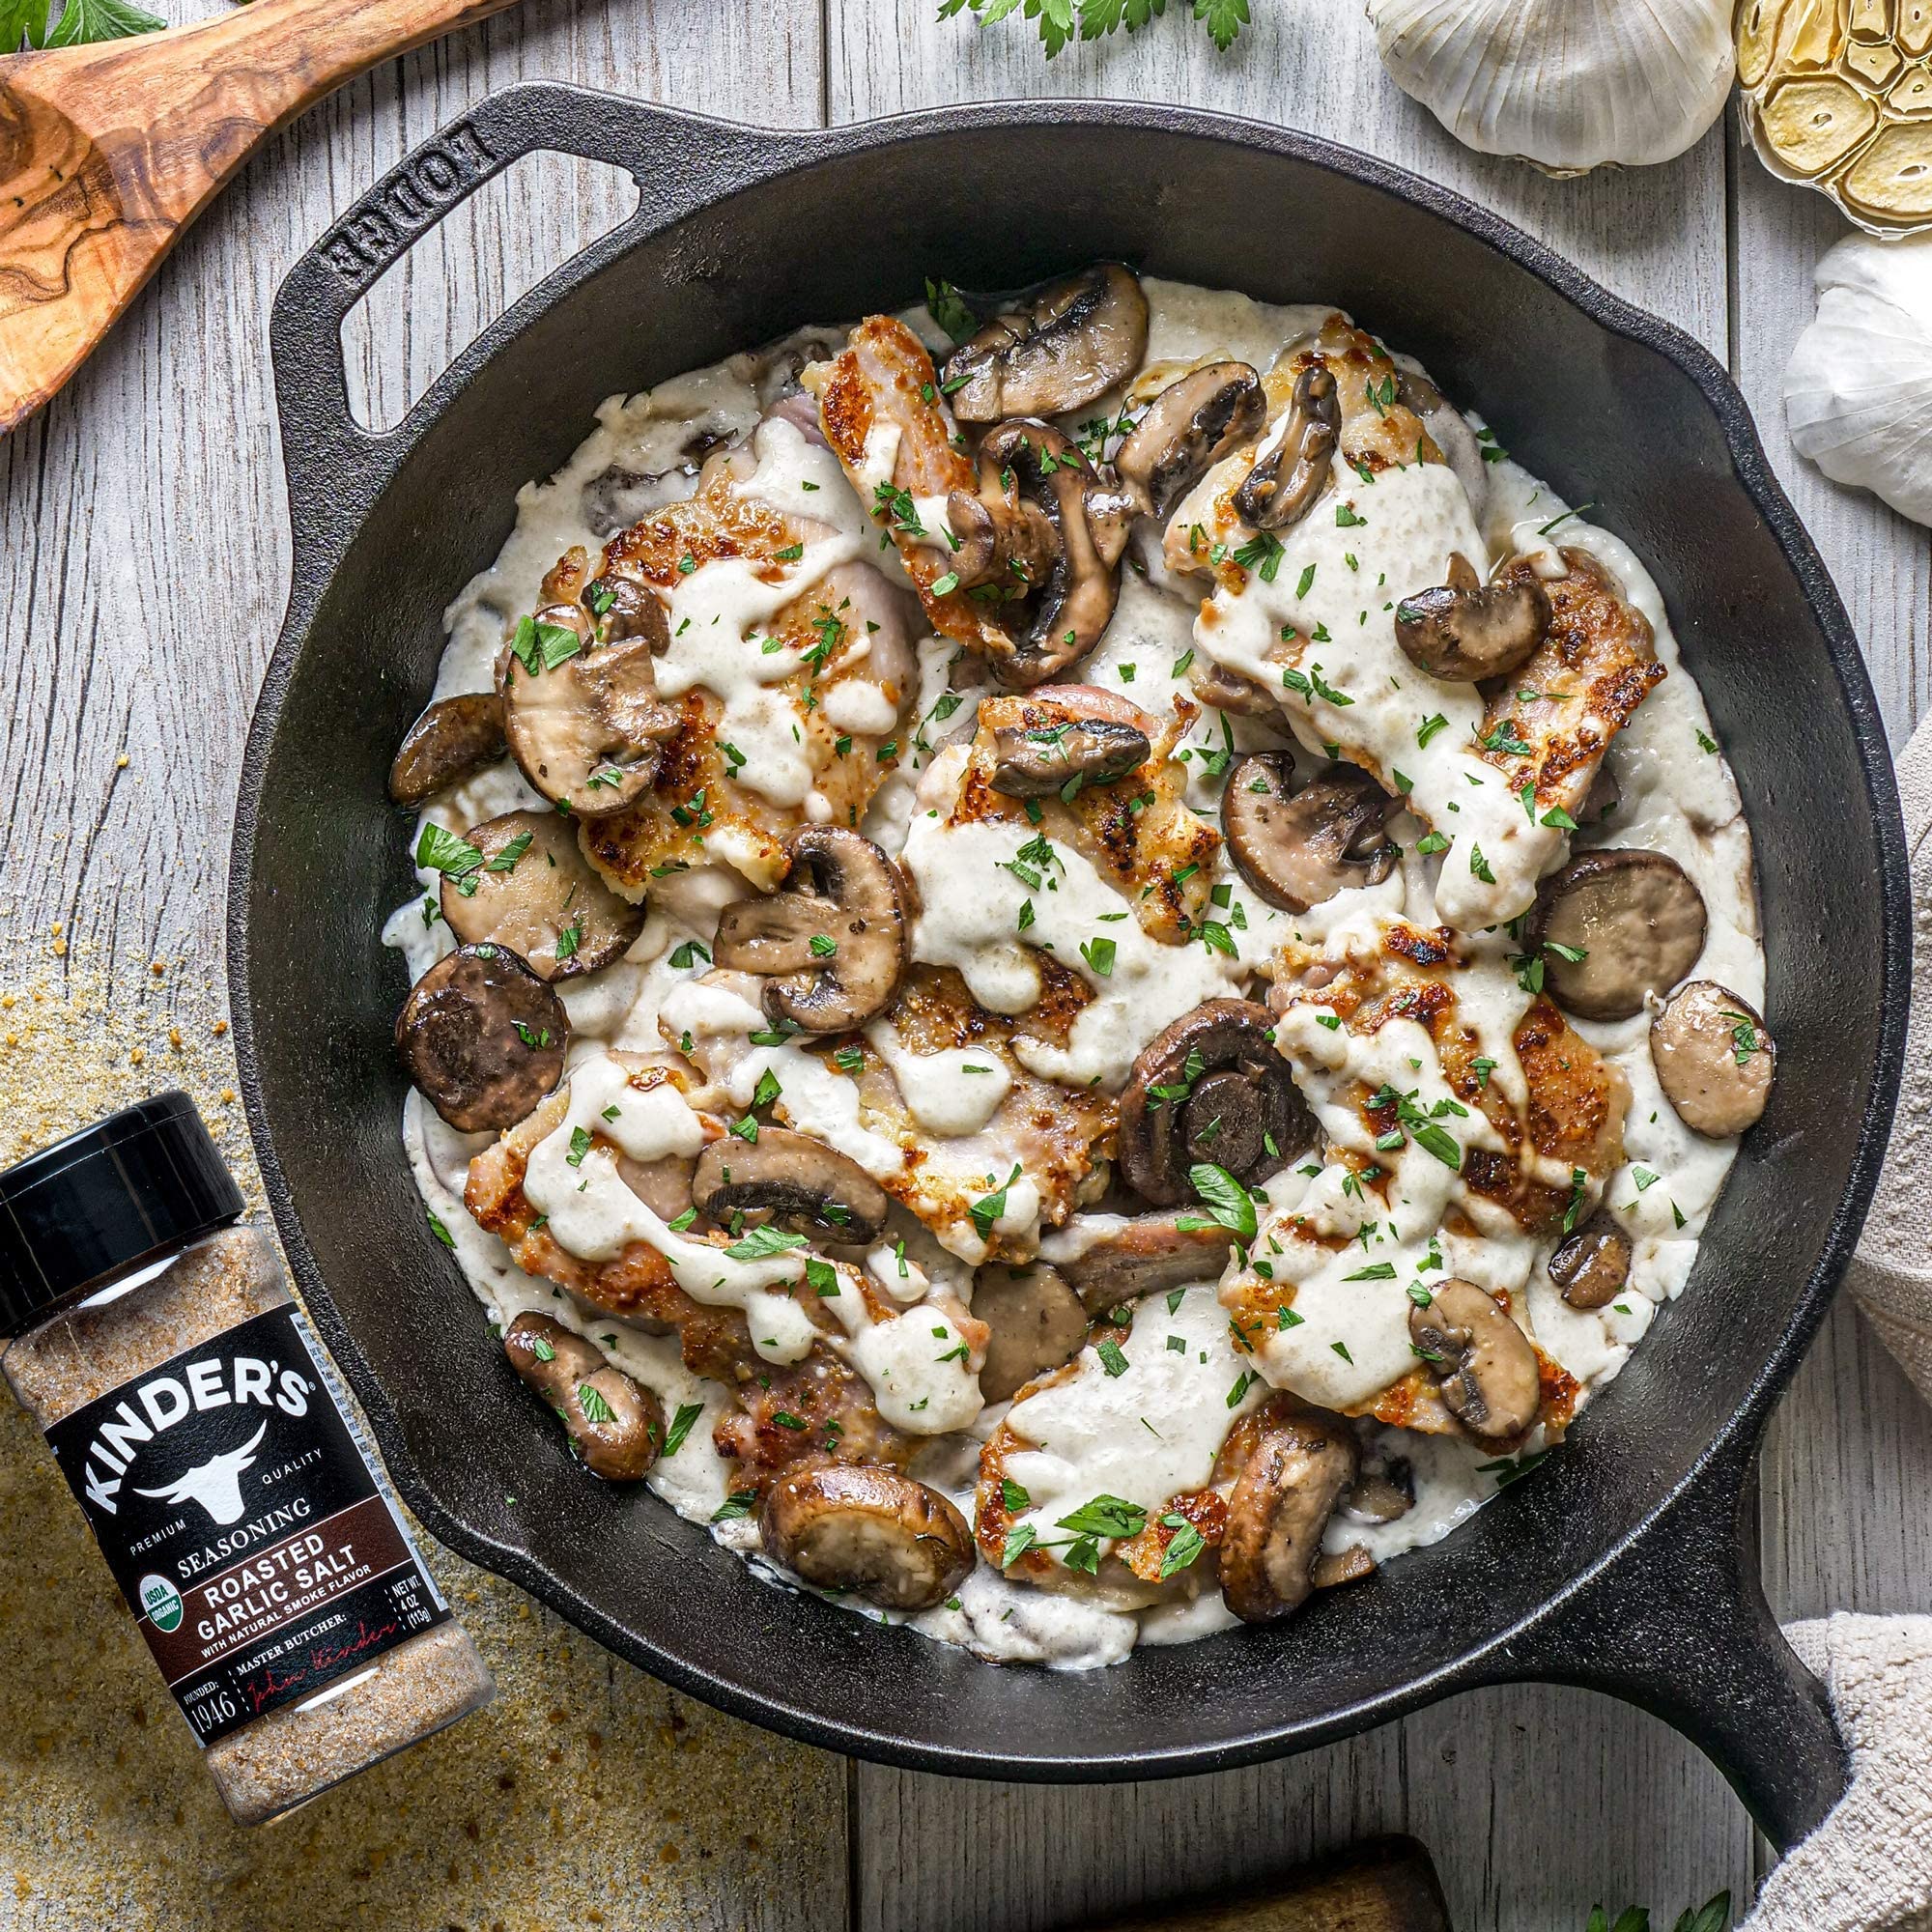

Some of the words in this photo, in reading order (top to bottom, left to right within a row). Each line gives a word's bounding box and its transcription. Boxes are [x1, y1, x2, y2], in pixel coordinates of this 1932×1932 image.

[319, 119, 497, 277] LODGE
[85, 1356, 310, 1516] KINDER'S
[129, 1518, 186, 1556] PREMIUM
[262, 1448, 323, 1485] QUALITY
[177, 1497, 311, 1578] SEASONING
[145, 1584, 169, 1605] USDA
[197, 1581, 289, 1640] GARLIC
[295, 1545, 357, 1589] SALT
[204, 1534, 325, 1608] ROASTED
[391, 1579, 410, 1598] NET
[407, 1575, 422, 1590] WT.
[400, 1599, 408, 1611] 4
[406, 1593, 419, 1608] OZ
[151, 1600, 180, 1622] ORGANIC
[201, 1638, 227, 1659] WITH
[229, 1611, 282, 1645] NATURAL
[283, 1587, 327, 1614] SMOKE
[329, 1564, 372, 1593] FLAVOR
[407, 1606, 432, 1630] (113g)
[235, 1644, 284, 1676] MASTER
[286, 1614, 347, 1651] BUTCHER:
[184, 1681, 219, 1705] FOUNDED:
[191, 1690, 236, 1733] 1946
